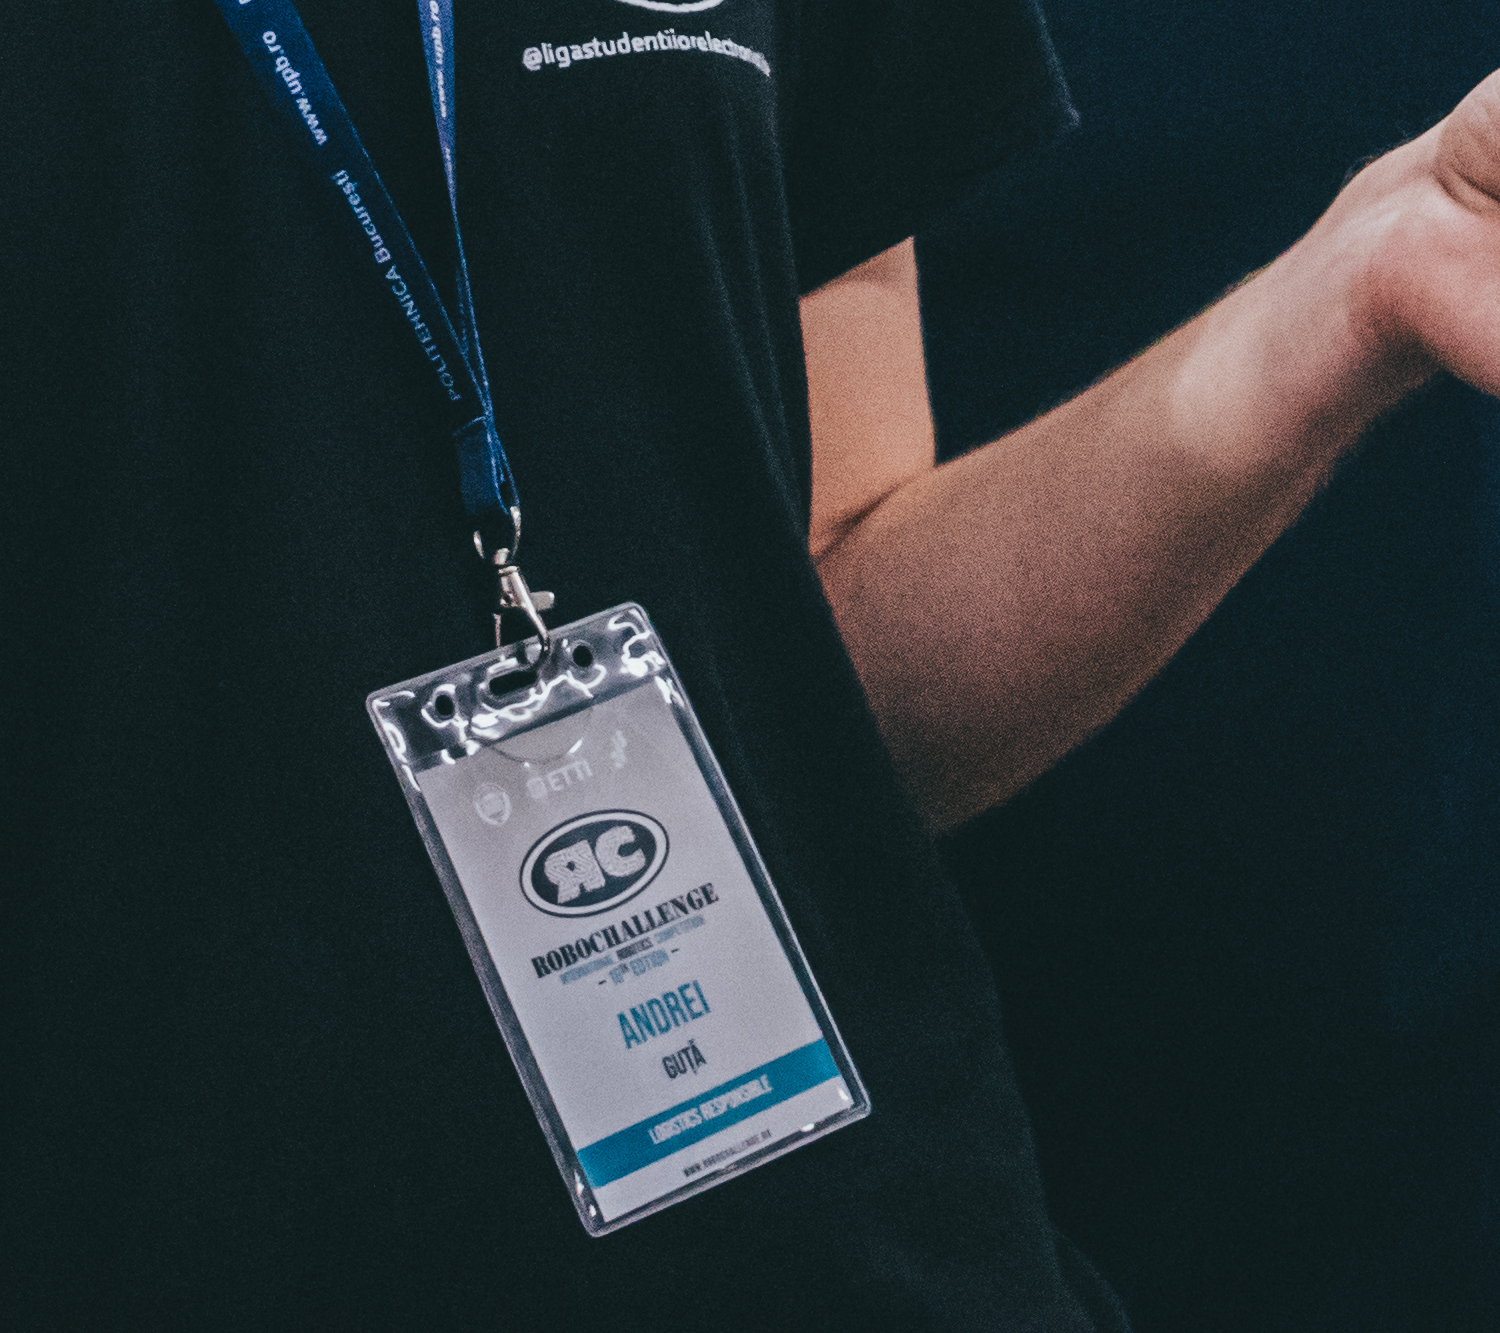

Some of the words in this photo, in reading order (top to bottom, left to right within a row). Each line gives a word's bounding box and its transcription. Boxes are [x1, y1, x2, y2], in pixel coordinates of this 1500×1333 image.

[262, 30, 329, 146] www.upb.ro
[384, 263, 462, 403] POLITEHNICA
[531, 882, 720, 979] ROBOCHALLENGE
[616, 979, 711, 1050] ANDREI
